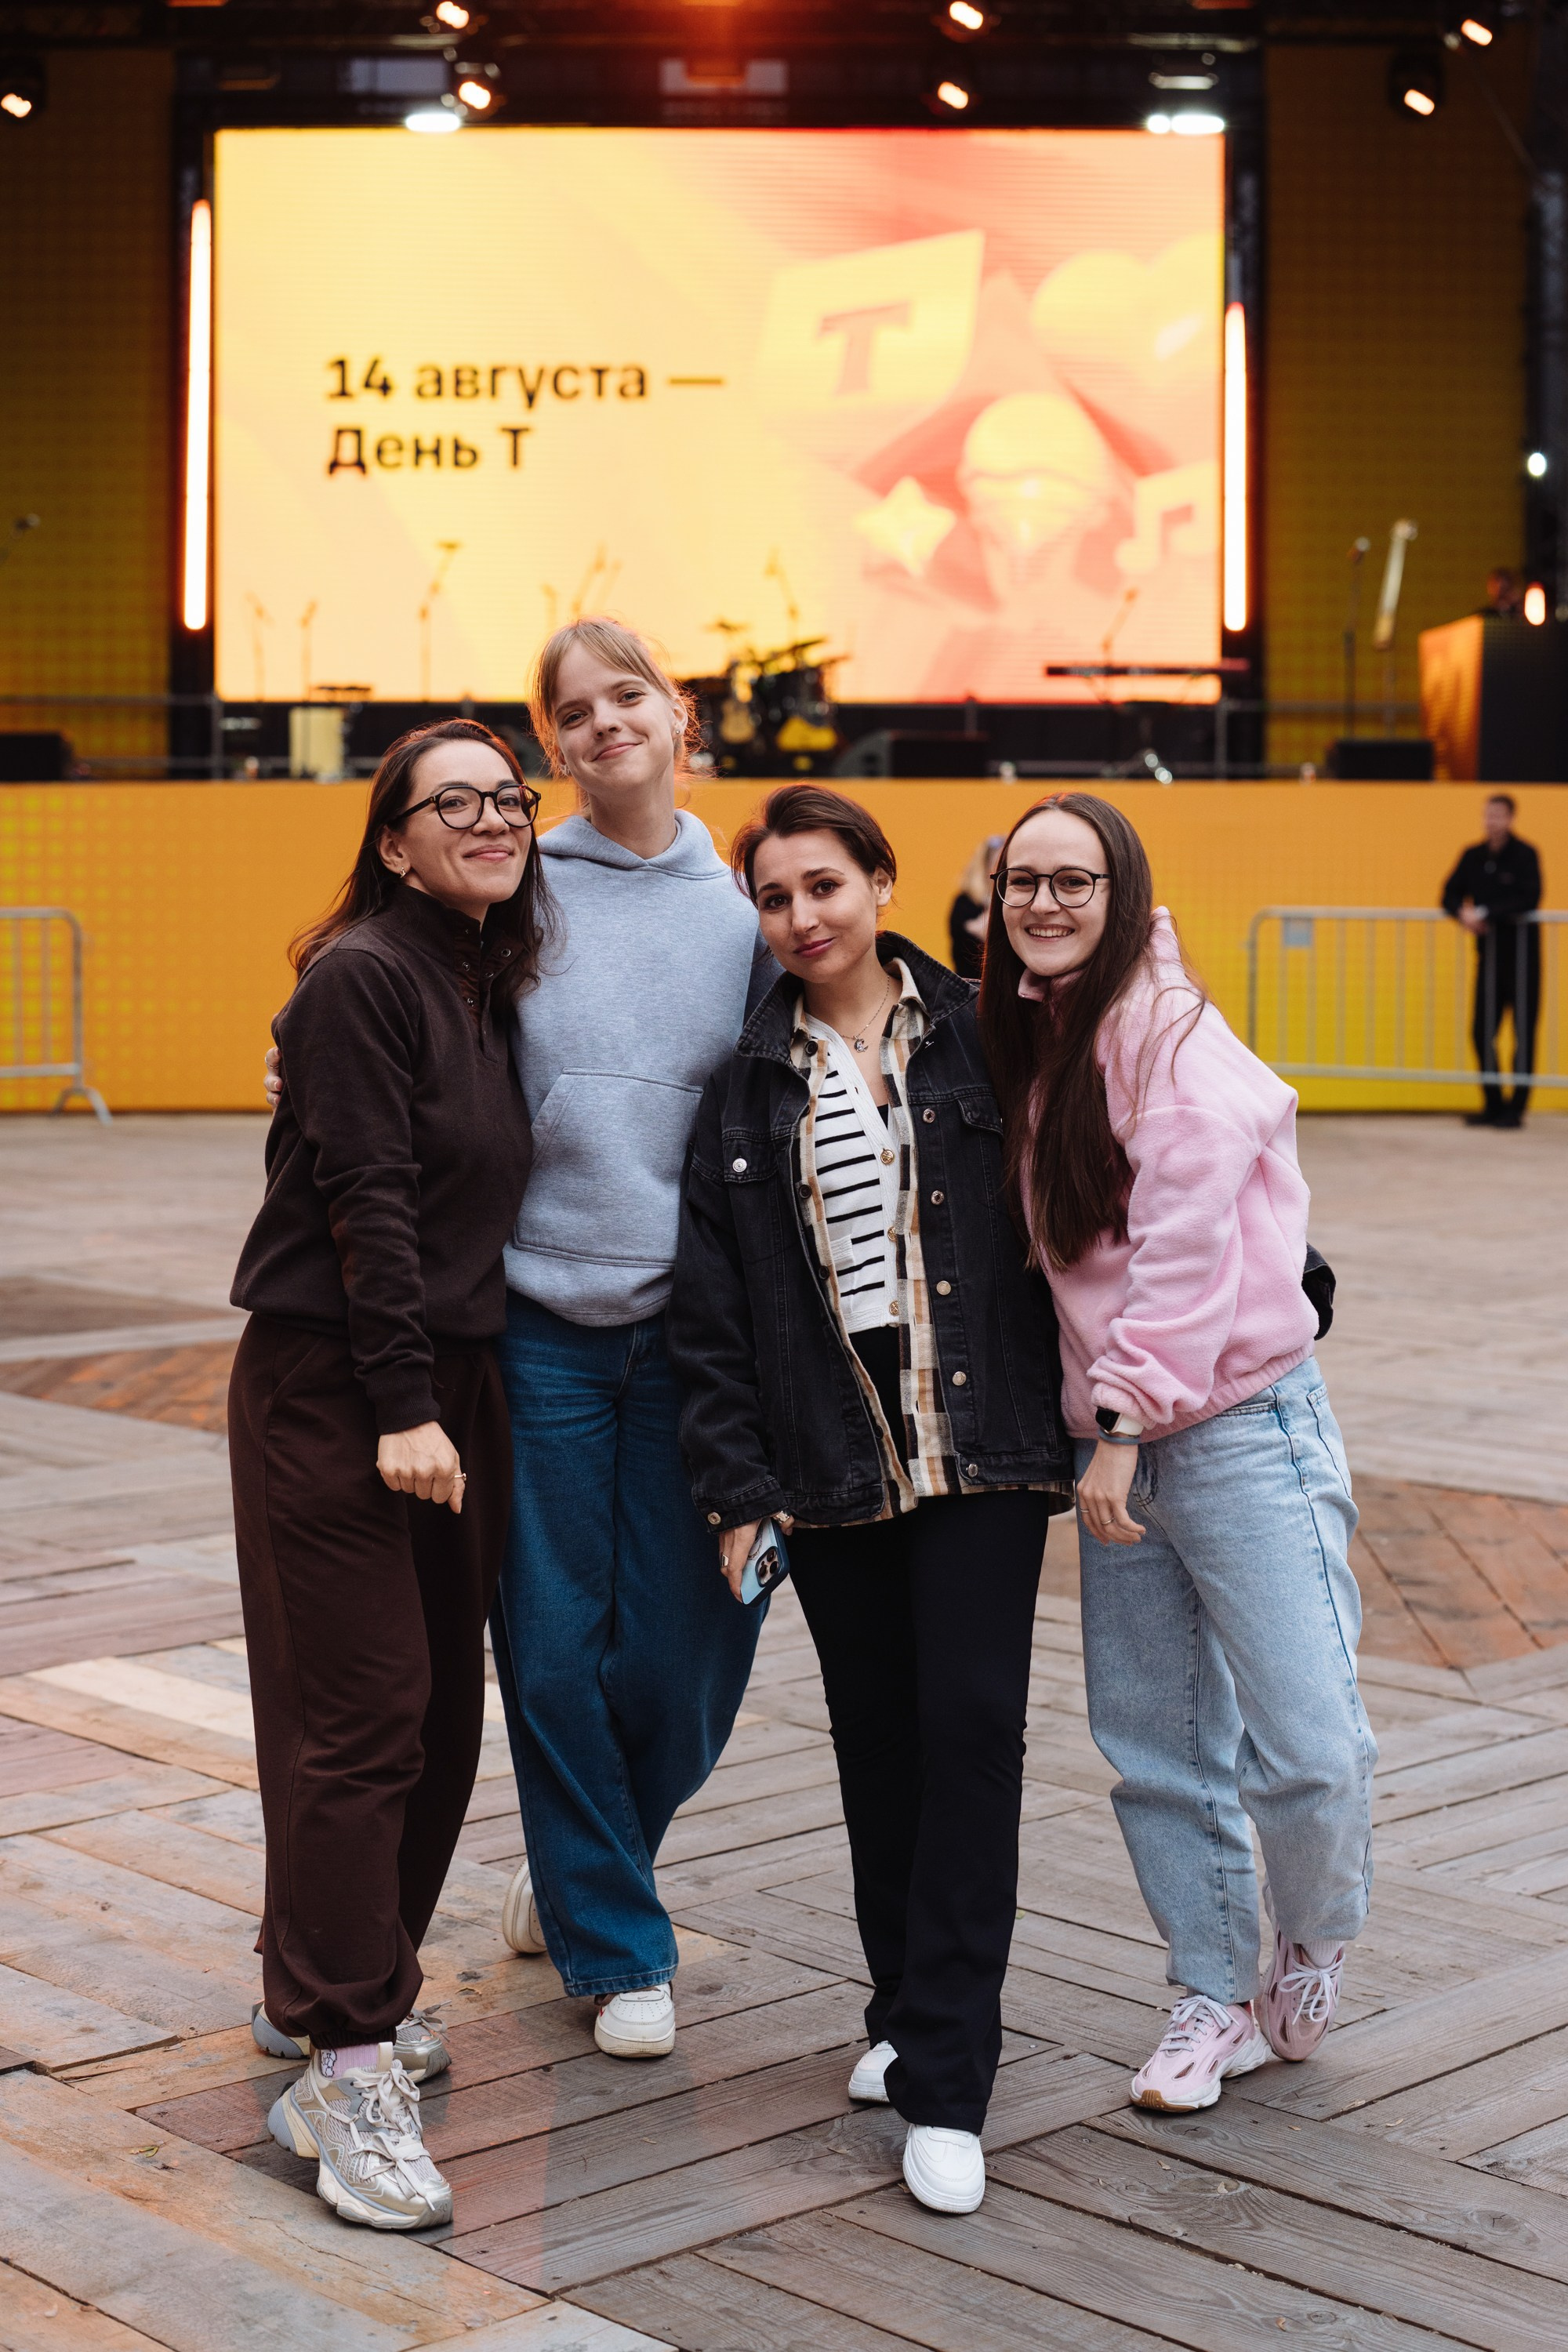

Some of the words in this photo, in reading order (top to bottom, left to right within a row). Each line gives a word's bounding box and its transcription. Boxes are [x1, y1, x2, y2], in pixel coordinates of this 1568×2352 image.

[328, 357, 394, 399] 14
[415, 365, 648, 411] августа
[325, 426, 480, 478] День
[499, 426, 532, 469] Т
